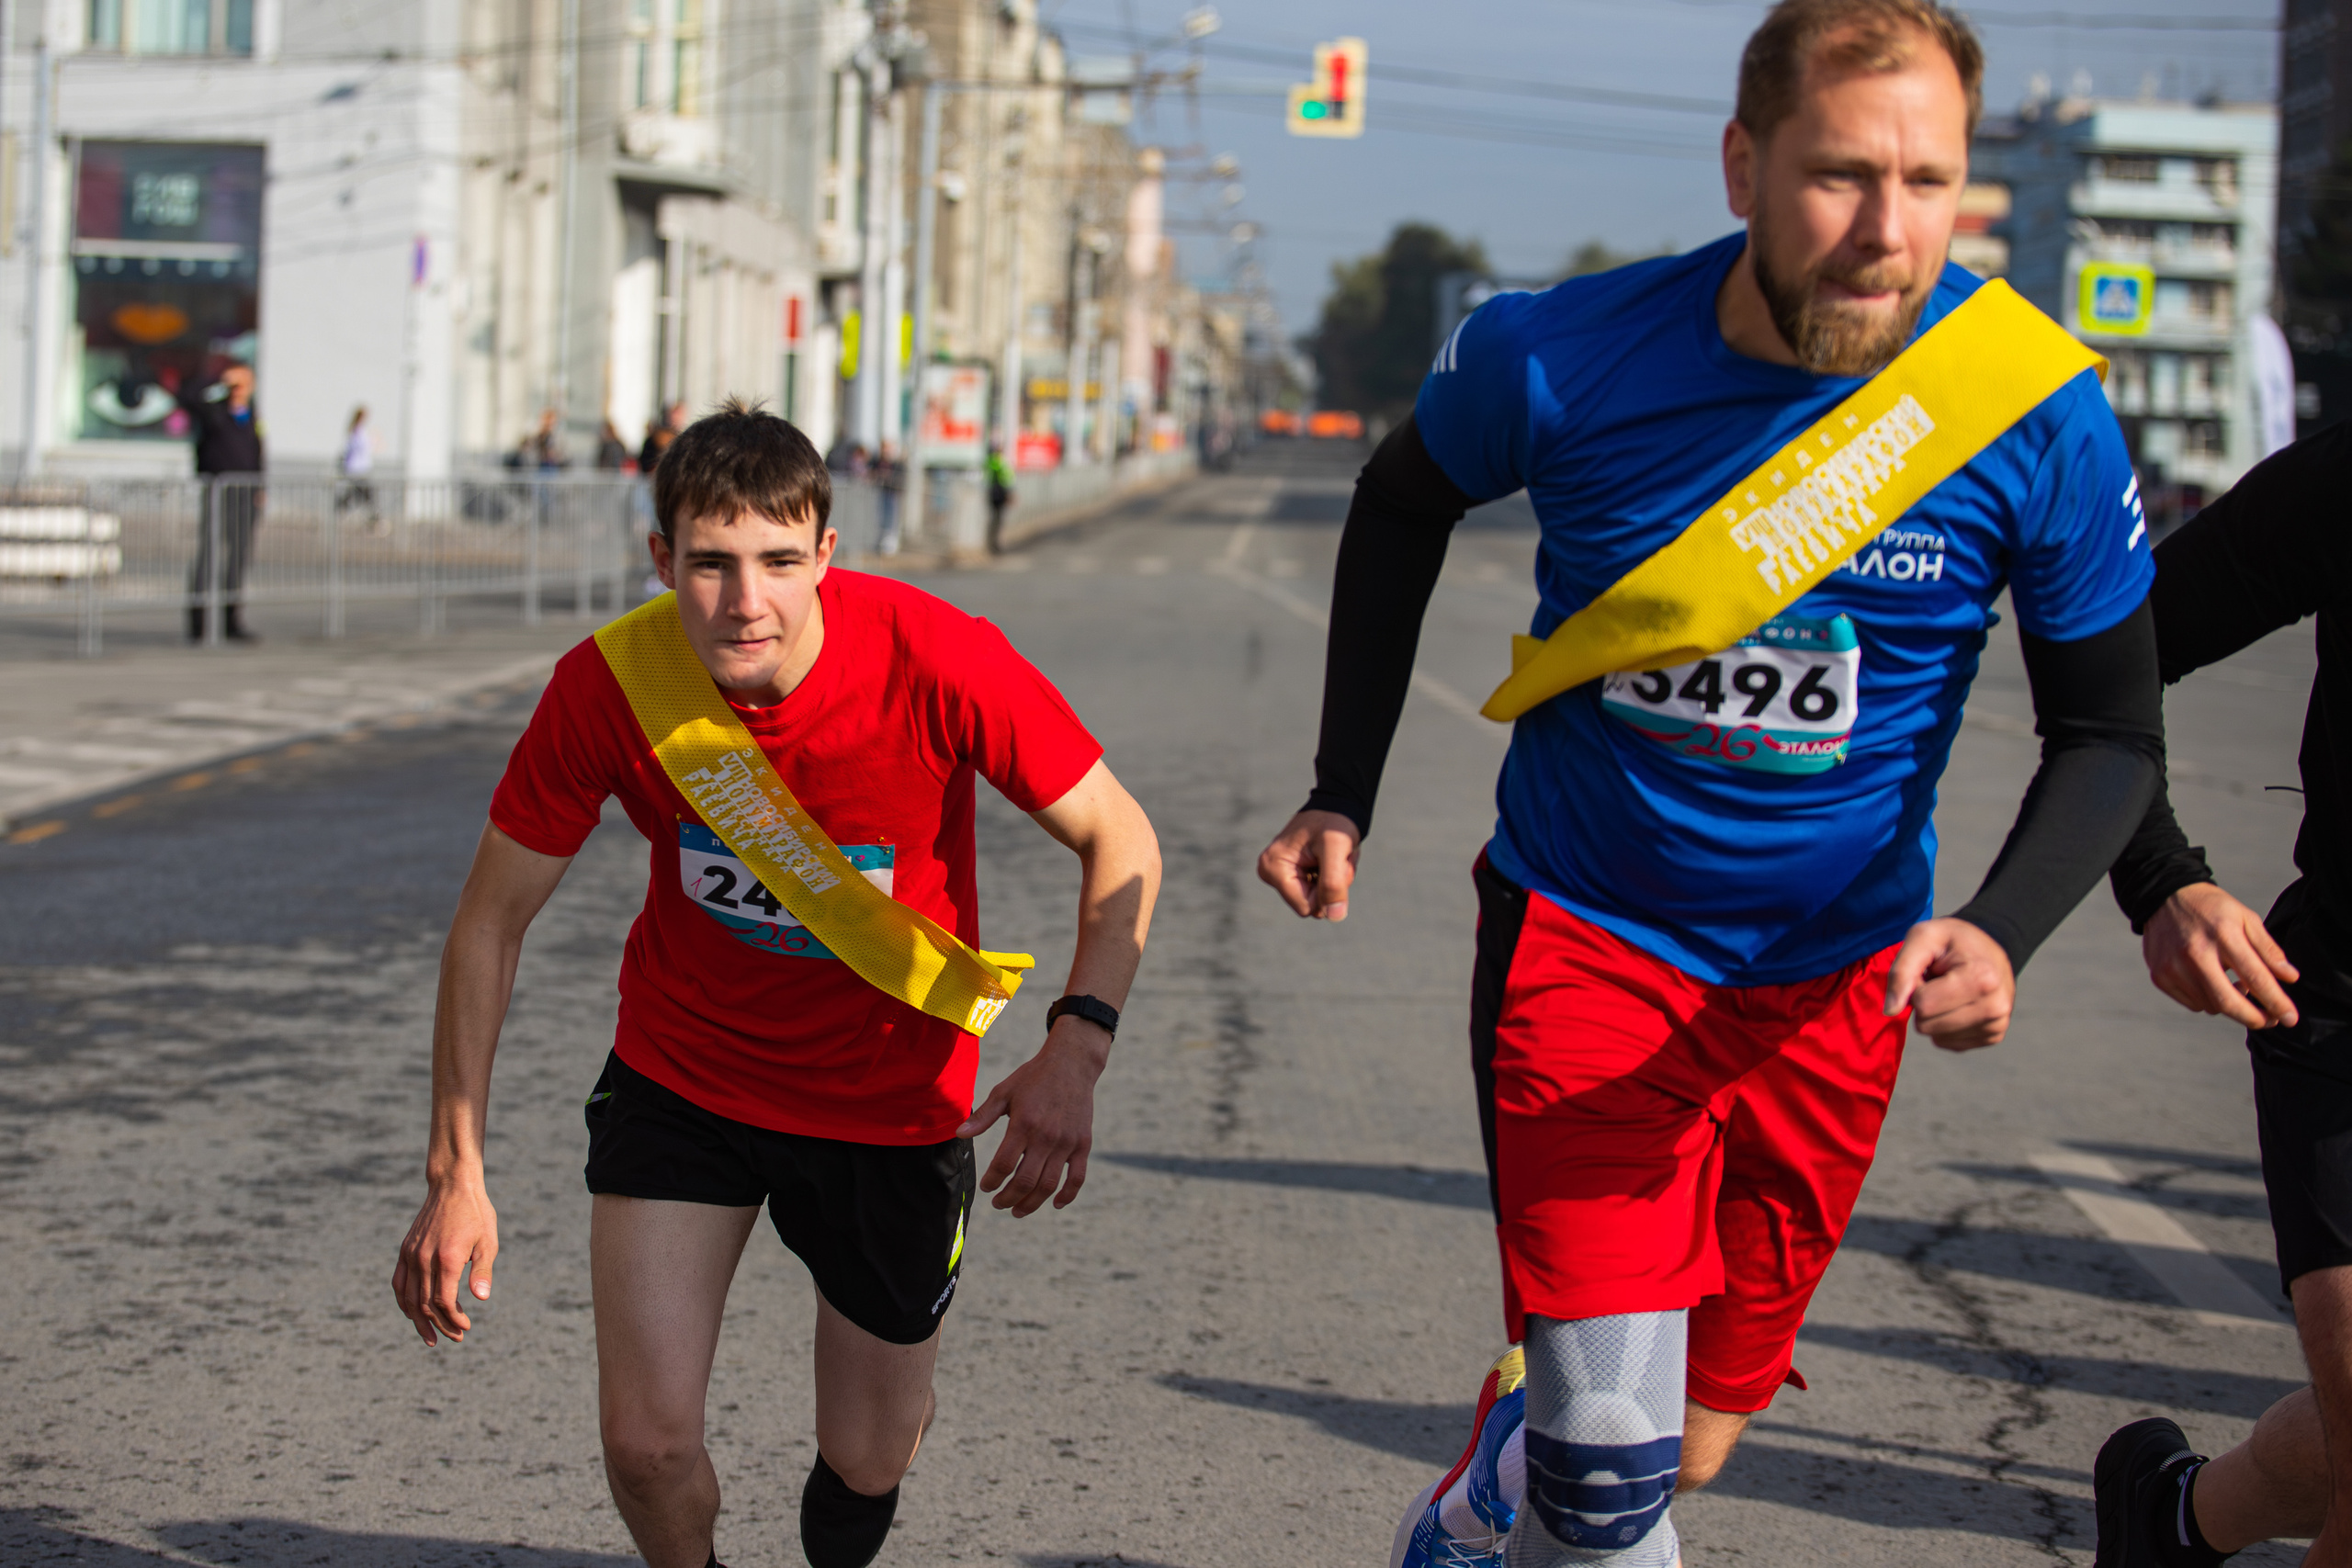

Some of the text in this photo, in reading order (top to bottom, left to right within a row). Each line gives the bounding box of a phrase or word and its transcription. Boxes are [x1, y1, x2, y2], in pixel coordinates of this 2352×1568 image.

[681, 770, 756, 851] РАЕВИЧА
[707, 781, 790, 874] АЛЕКСАНДРА
[721, 774, 825, 889] ПОЛУМАРАФОН
[741, 747, 827, 852] ЭКИДЕН
[741, 778, 842, 886] НОВОСИБИРСКИЙ
[703, 865, 799, 920] 24
